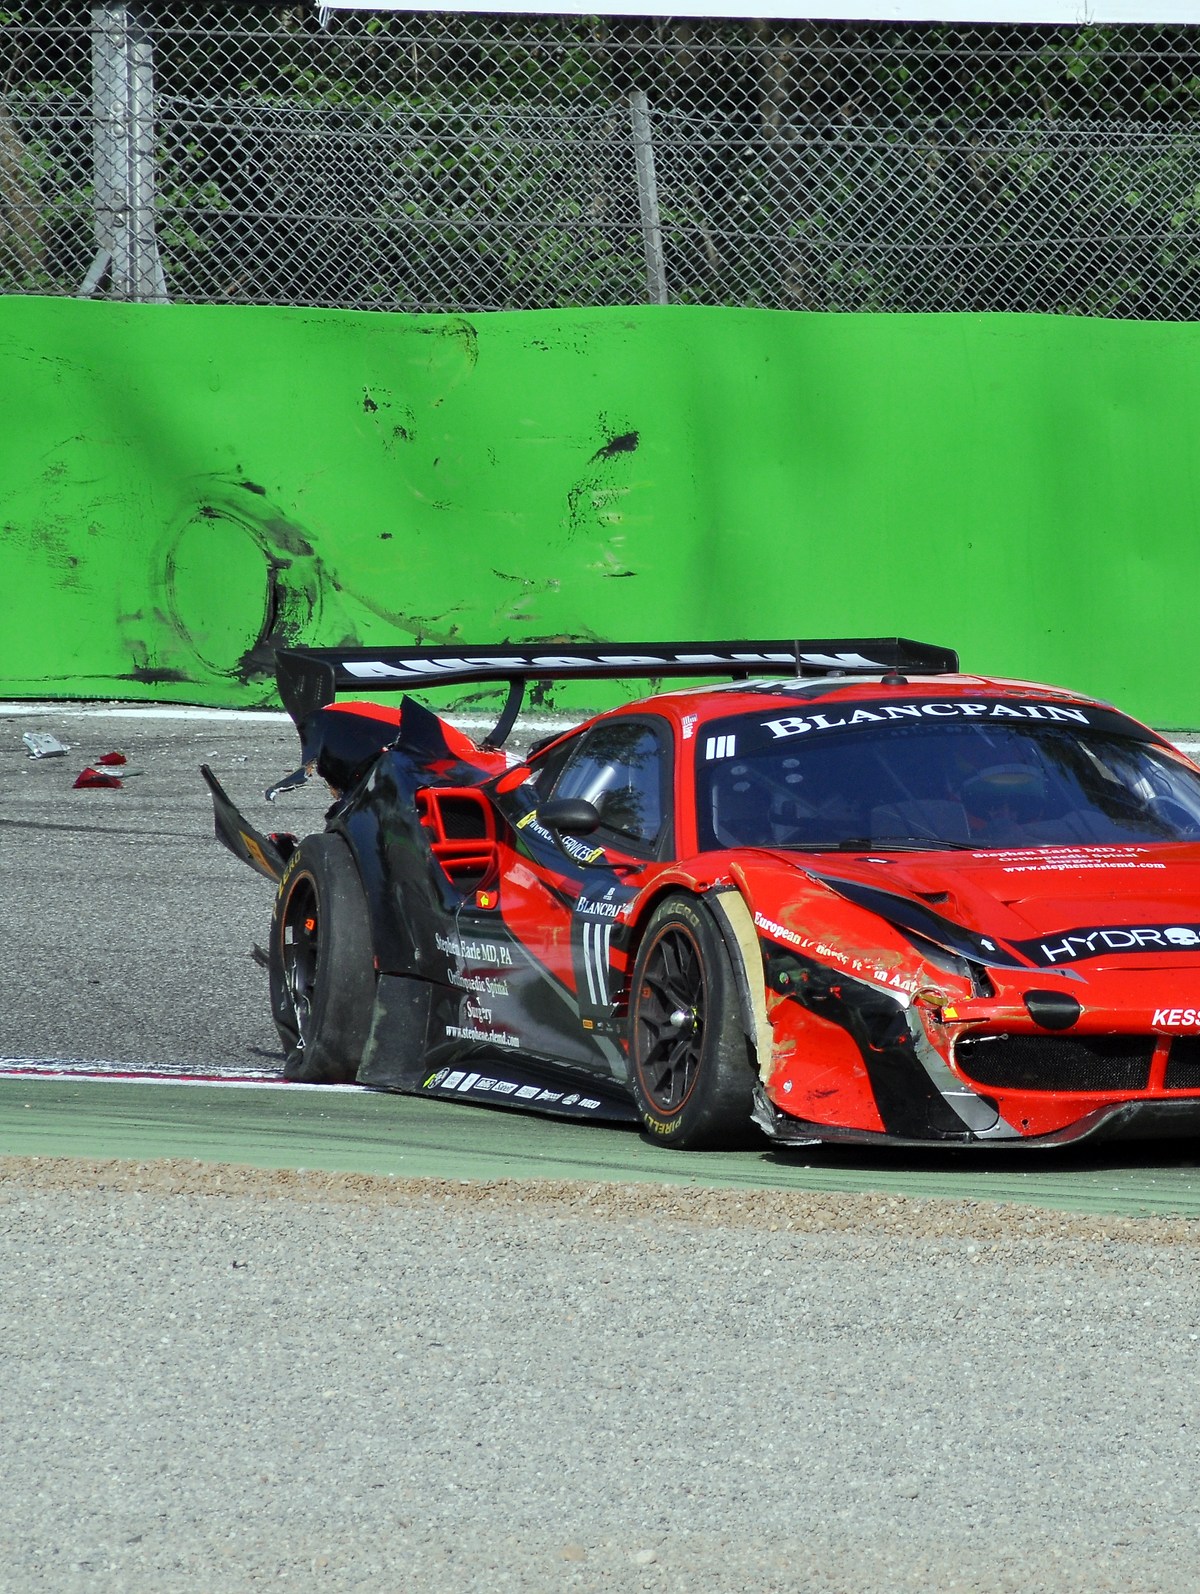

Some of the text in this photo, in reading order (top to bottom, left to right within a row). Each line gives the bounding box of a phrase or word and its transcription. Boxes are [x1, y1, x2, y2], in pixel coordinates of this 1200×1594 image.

[760, 703, 1091, 739] BLANCPAIN
[754, 912, 801, 945] European
[435, 933, 513, 967] Stephen Earle MD, PA
[644, 1113, 682, 1135] PIRELLI
